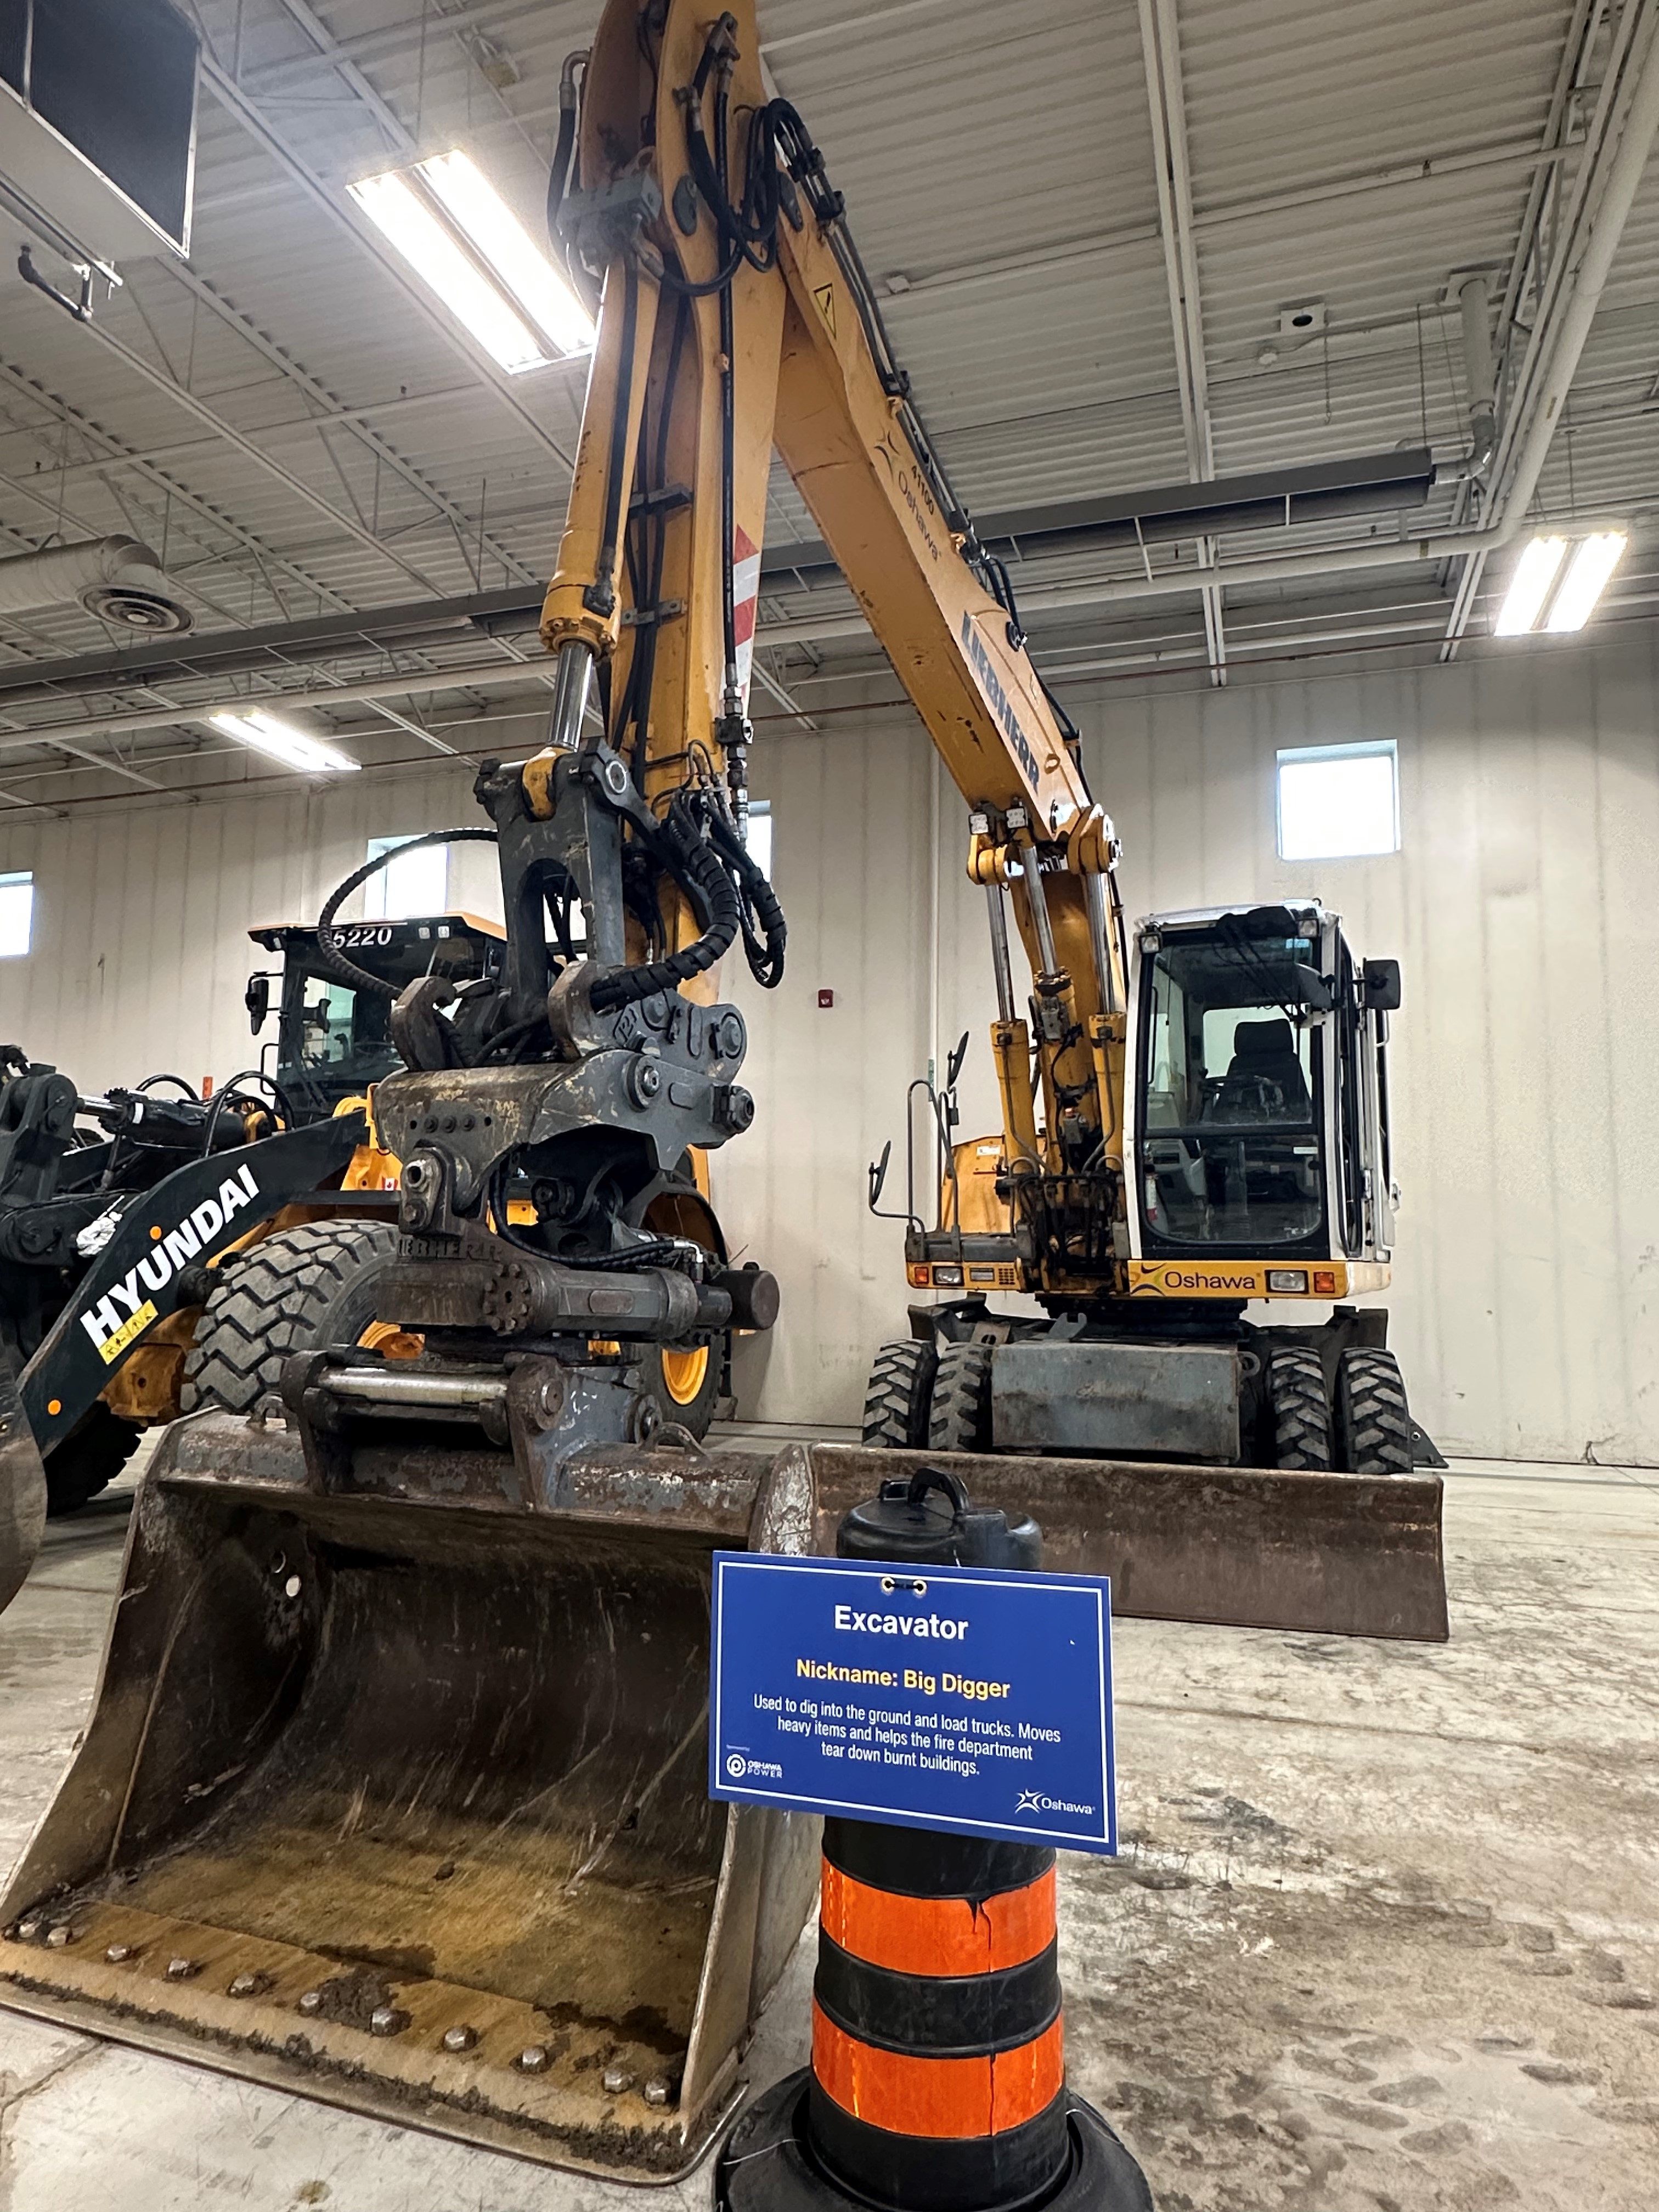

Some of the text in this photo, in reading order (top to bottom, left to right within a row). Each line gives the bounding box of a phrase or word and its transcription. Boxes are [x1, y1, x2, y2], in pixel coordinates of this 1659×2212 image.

[899, 471, 938, 562] Oshawa
[961, 610, 1039, 797] LIEBHERR
[332, 927, 392, 949] 5220
[80, 1163, 259, 1349] HYUNDAI
[1165, 1272, 1255, 1289] Oshawa
[834, 1605, 969, 1640] Excavator
[797, 1658, 1010, 1701] Nickname: Big Digger
[754, 1693, 1061, 1742] Used to dig into the ground and load trucks. Moves
[777, 1715, 1033, 1760] heavy items and helps the fire department
[747, 1767, 782, 1778] POWER
[821, 1741, 980, 1778] tear down burnt buildings.
[1041, 1797, 1093, 1815] Oshawa
